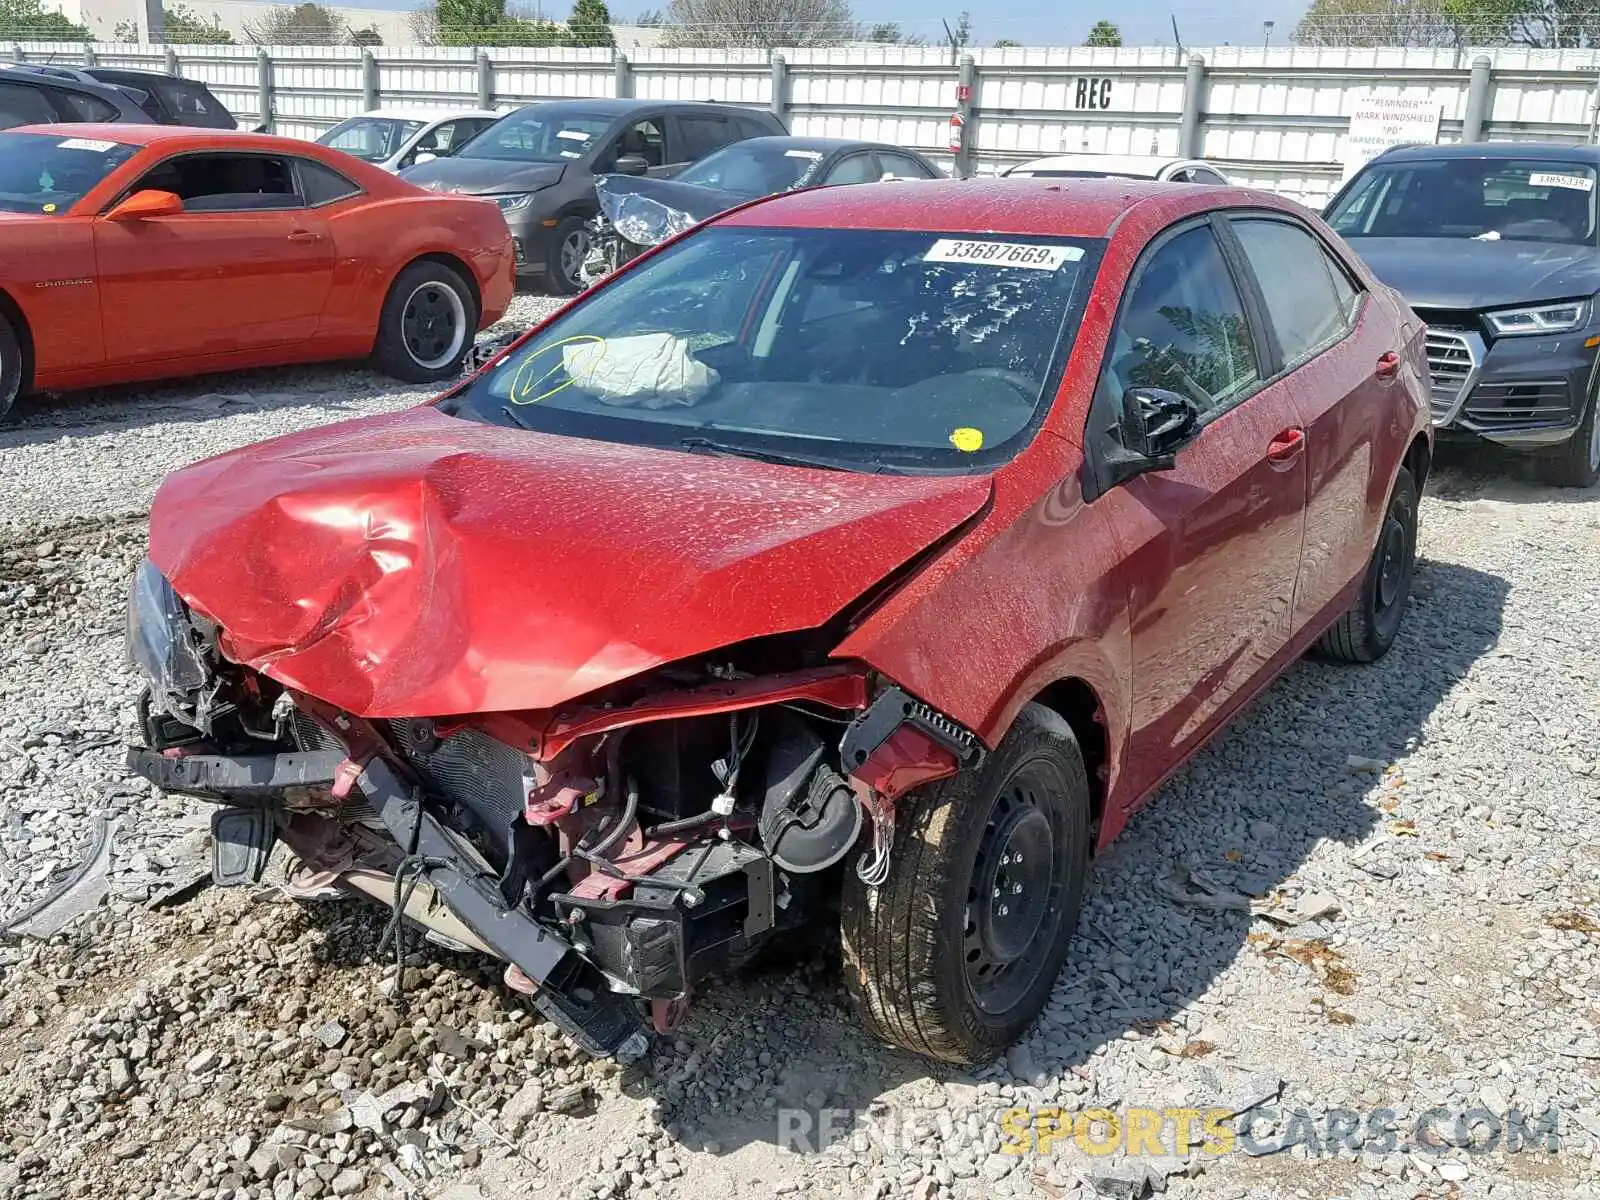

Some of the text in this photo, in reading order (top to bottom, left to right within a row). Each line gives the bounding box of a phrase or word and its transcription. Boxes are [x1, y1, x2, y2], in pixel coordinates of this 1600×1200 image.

[1075, 77, 1112, 109] REC
[1354, 111, 1435, 123] MARK WINDSHIELD
